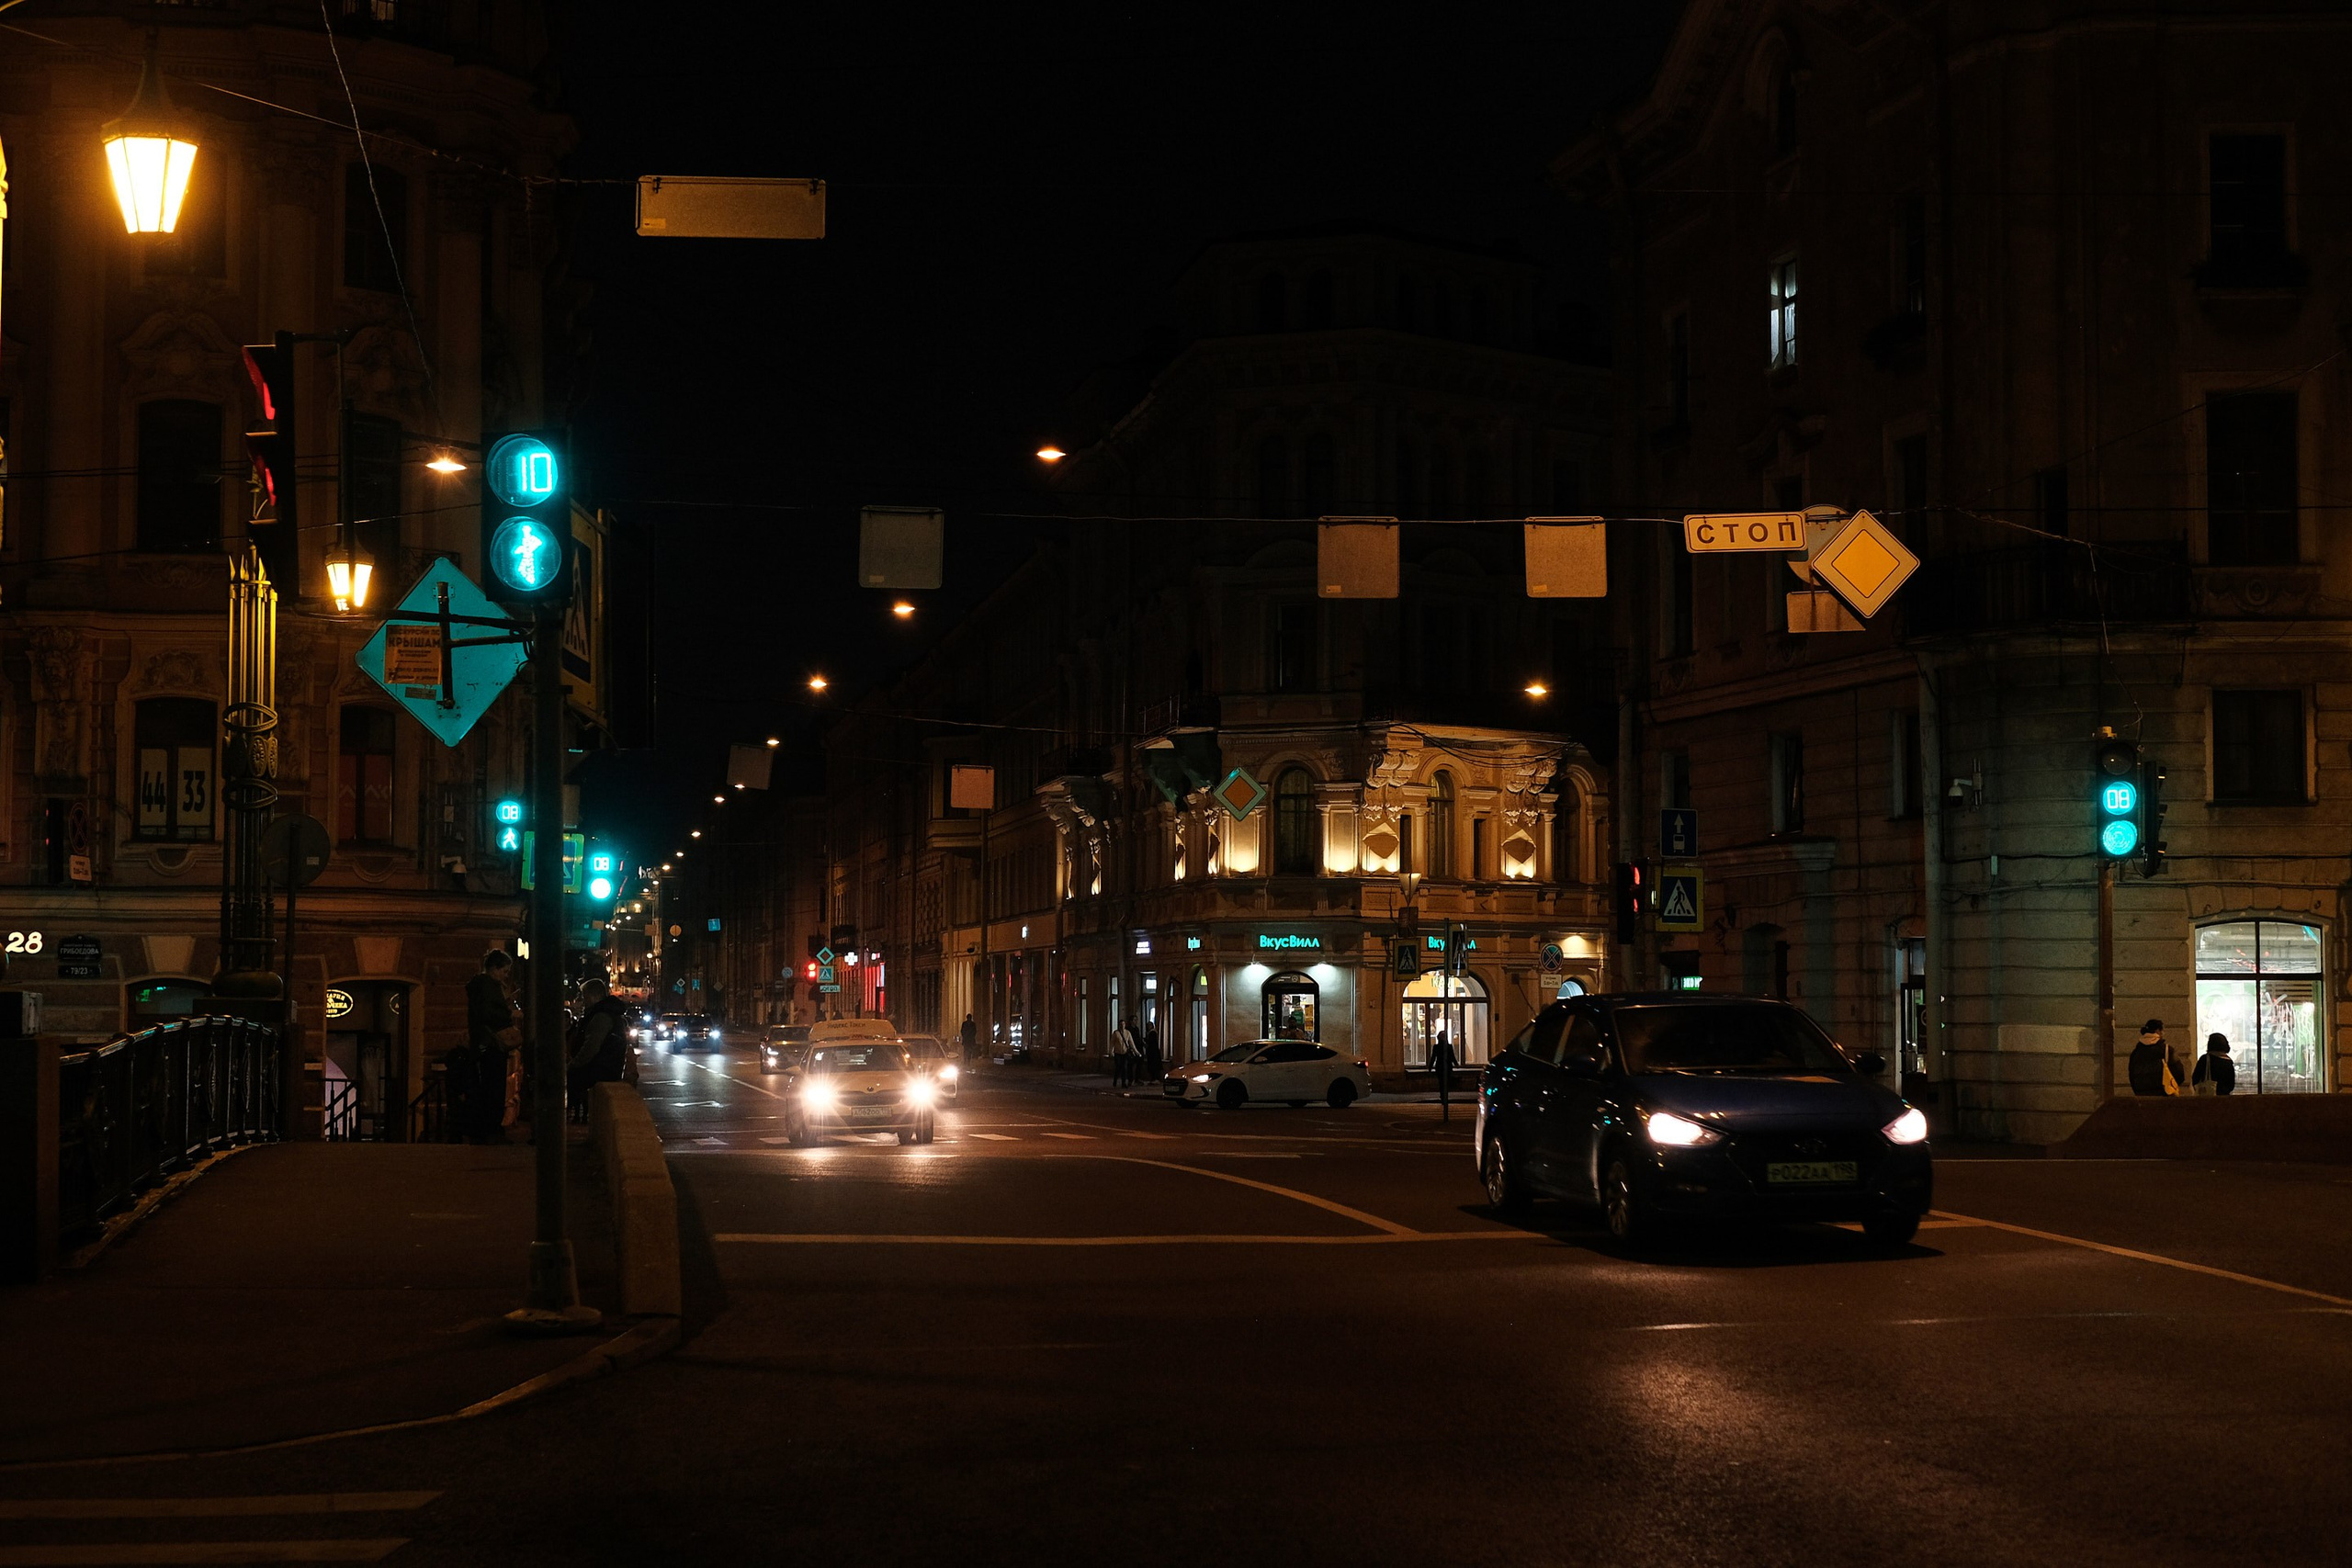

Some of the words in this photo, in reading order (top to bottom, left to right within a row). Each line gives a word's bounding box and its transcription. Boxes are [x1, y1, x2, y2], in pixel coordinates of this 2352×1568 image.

[521, 453, 552, 493] 10
[1696, 522, 1796, 544] СТОП
[389, 637, 441, 648] КРЫШАМ
[142, 772, 165, 812] 44
[183, 771, 205, 812] 33
[2107, 789, 2130, 808] 08
[502, 805, 518, 819] 08
[594, 857, 609, 871] 08
[5, 931, 43, 954] 28
[60, 947, 99, 955] ГРИБОЕДОВА
[1260, 935, 1320, 951] ВкусВилл
